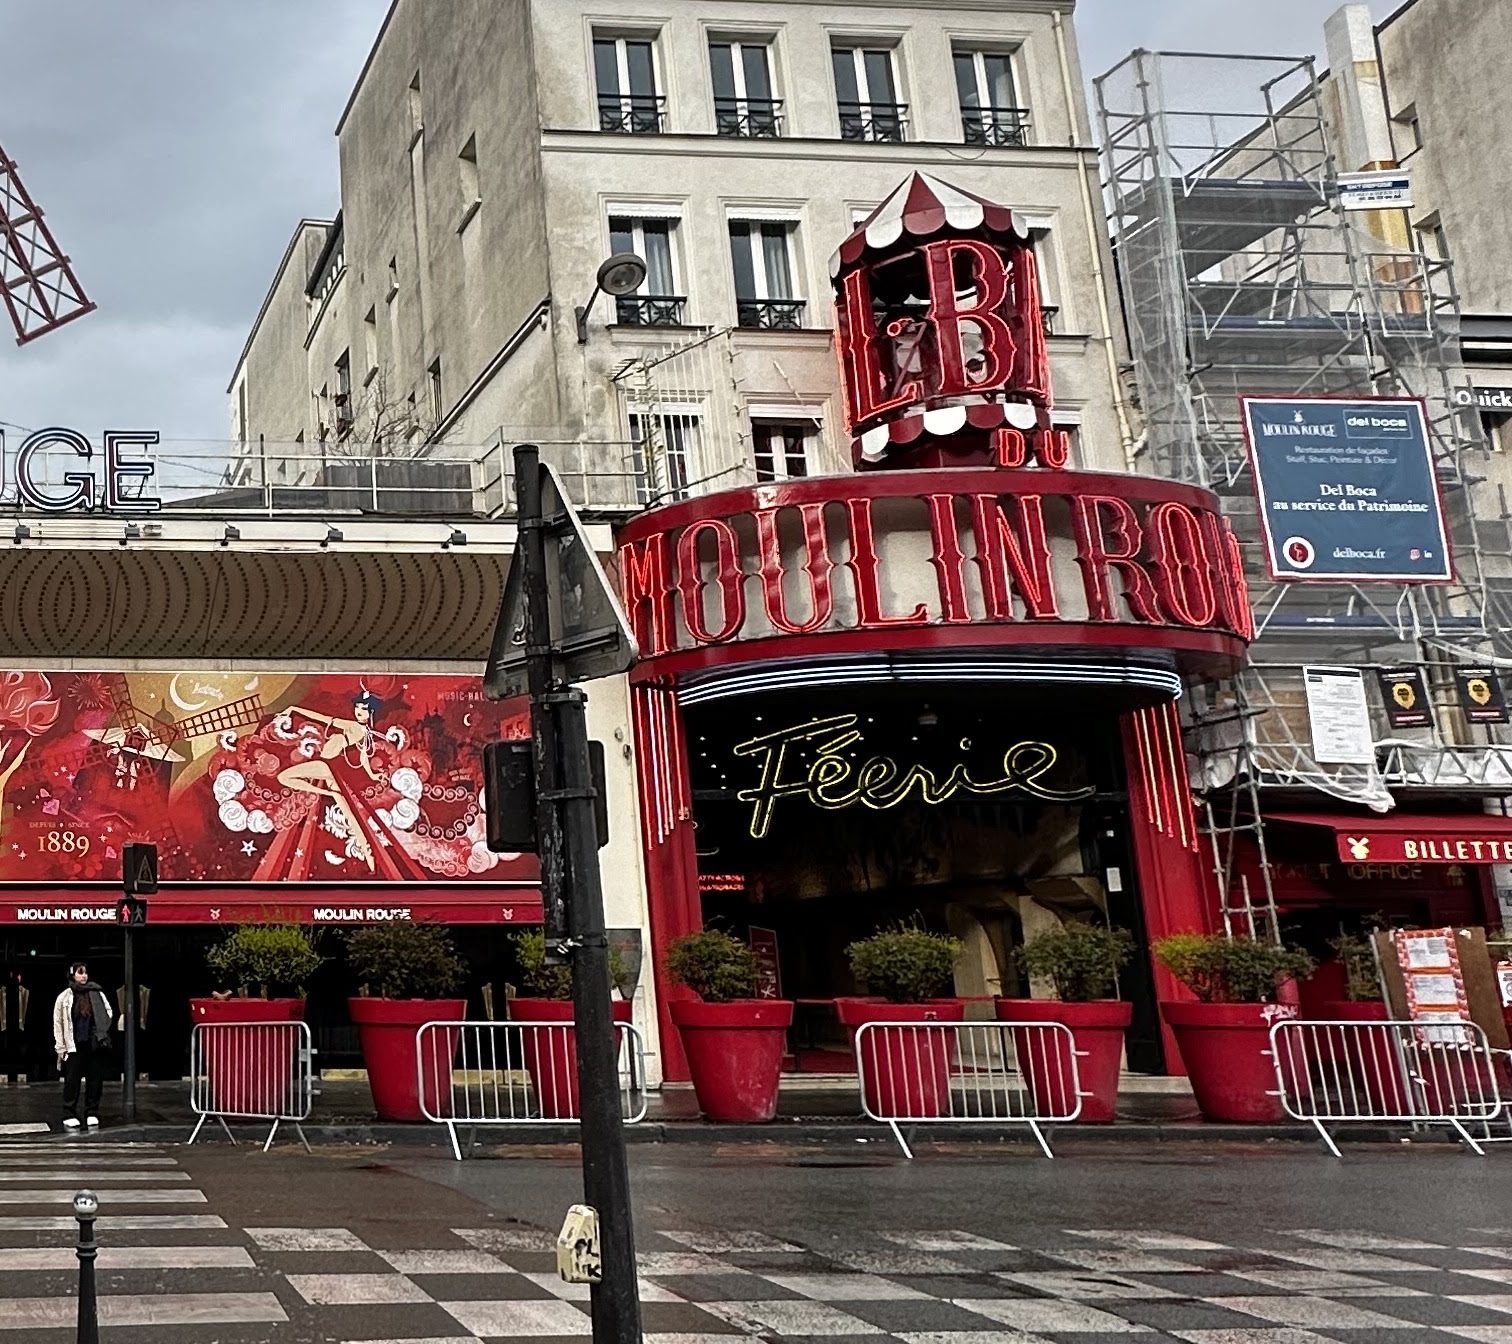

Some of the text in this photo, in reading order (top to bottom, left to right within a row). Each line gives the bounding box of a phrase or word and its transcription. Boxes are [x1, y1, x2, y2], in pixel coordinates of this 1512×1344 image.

[1347, 416, 1407, 427] del boca
[1263, 422, 1337, 438] MOULIN ROUGE
[997, 428, 1071, 469] DU
[1320, 484, 1377, 497] Del Boca
[1273, 498, 1429, 513] au service du Patrimoine
[1333, 548, 1386, 559] delboca.fr
[620, 493, 1060, 656] MOULIN
[437, 691, 490, 702] MUSIC-HAL
[733, 713, 1096, 839] Féerie
[38, 830, 90, 858] 1889
[1404, 840, 1512, 861] BILLETTE
[1347, 862, 1423, 881] OFFICE
[17, 908, 117, 920] MOULIN ROUGE
[313, 908, 364, 920] MOULIN
